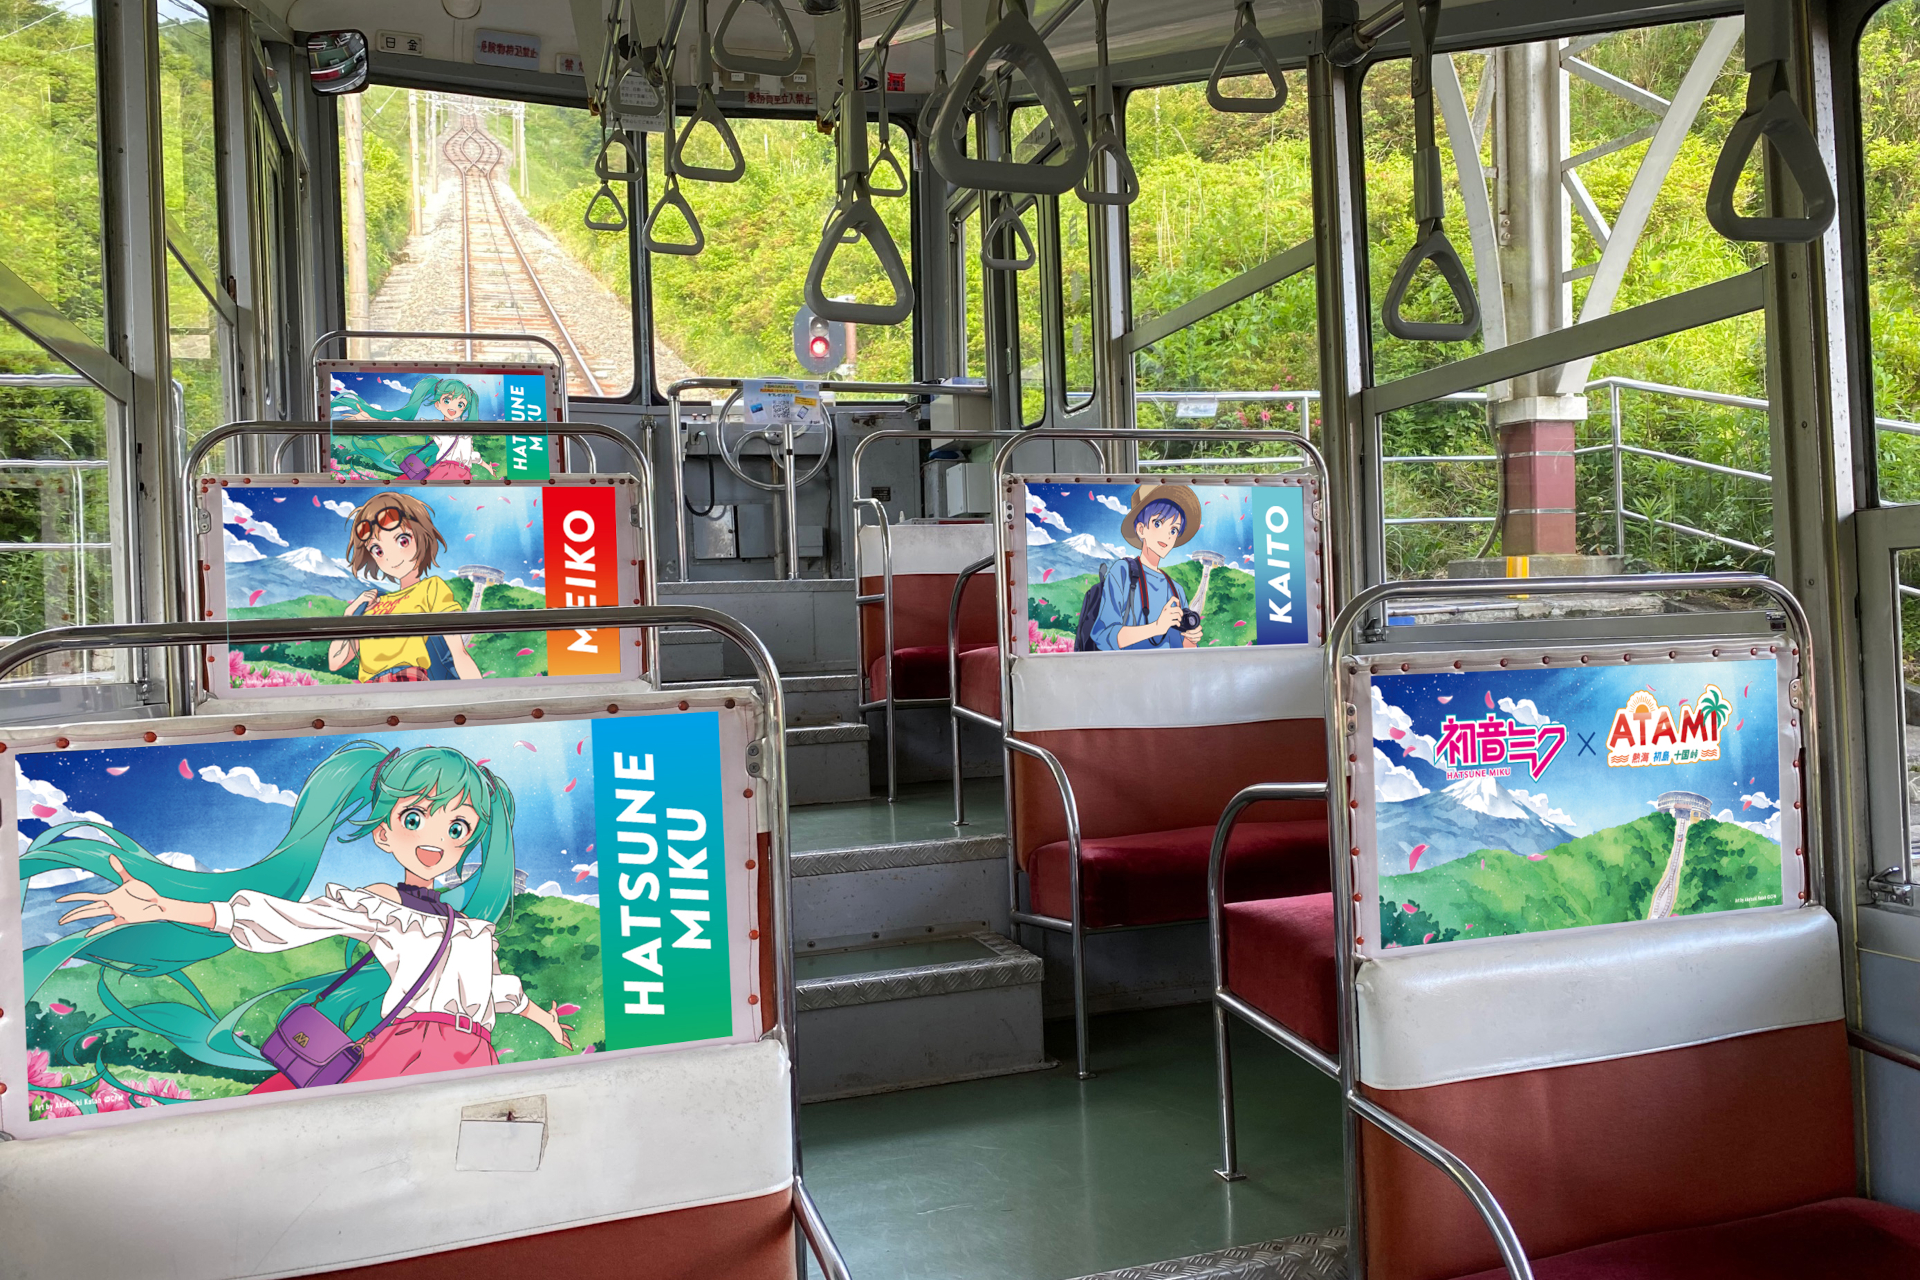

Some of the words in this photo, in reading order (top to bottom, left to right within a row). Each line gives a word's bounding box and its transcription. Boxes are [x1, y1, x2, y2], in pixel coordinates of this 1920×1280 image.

[510, 385, 527, 470] HATUNE
[527, 404, 543, 451] MU
[562, 510, 598, 653] MEIKO
[1265, 505, 1293, 624] KAITO
[1435, 714, 1567, 780] 初音ミク
[1609, 709, 1718, 748] ATAMI
[1631, 752, 1650, 764] 熱海
[1653, 751, 1670, 763] 初島
[1674, 749, 1699, 761] 十国峠
[1446, 769, 1486, 780] HATSUNE
[1489, 767, 1511, 777] MIKU
[613, 751, 666, 1015] HATSUNE
[666, 808, 712, 950] MIKU
[34, 1104, 44, 1112] Art
